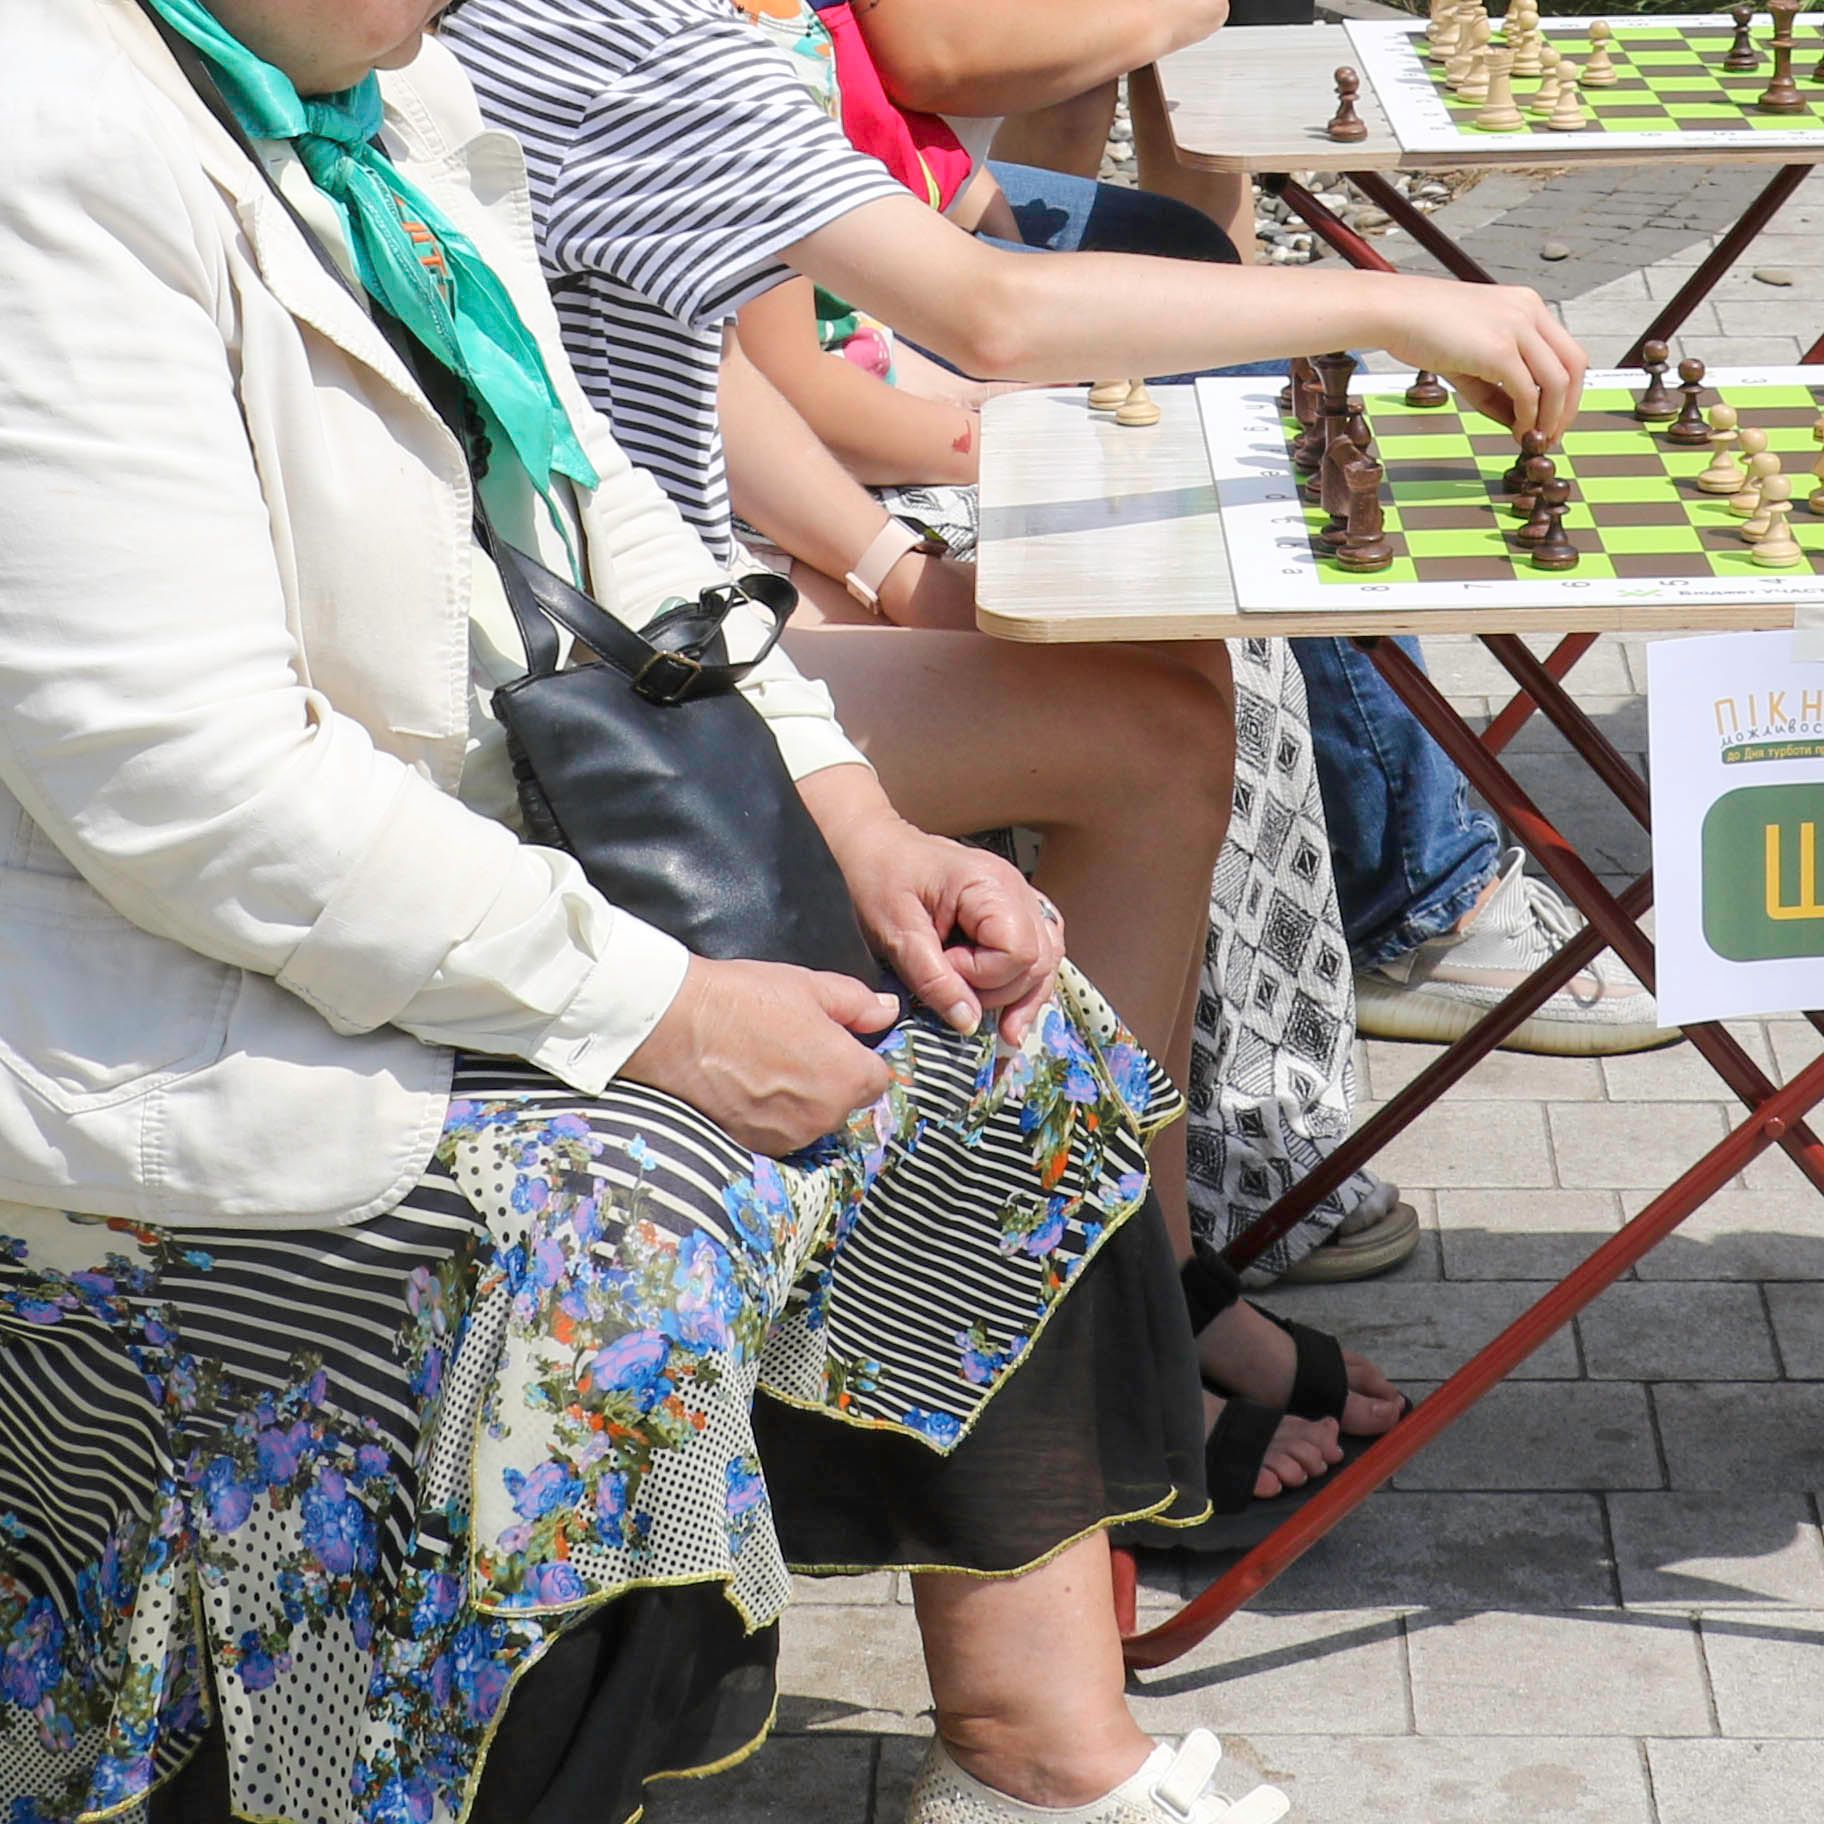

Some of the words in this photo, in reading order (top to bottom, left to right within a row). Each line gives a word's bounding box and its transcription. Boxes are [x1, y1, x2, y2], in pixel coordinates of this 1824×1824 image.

[1727, 751, 1741, 762] до
[1743, 747, 1764, 761] Дня
[1768, 744, 1812, 759] турботи
